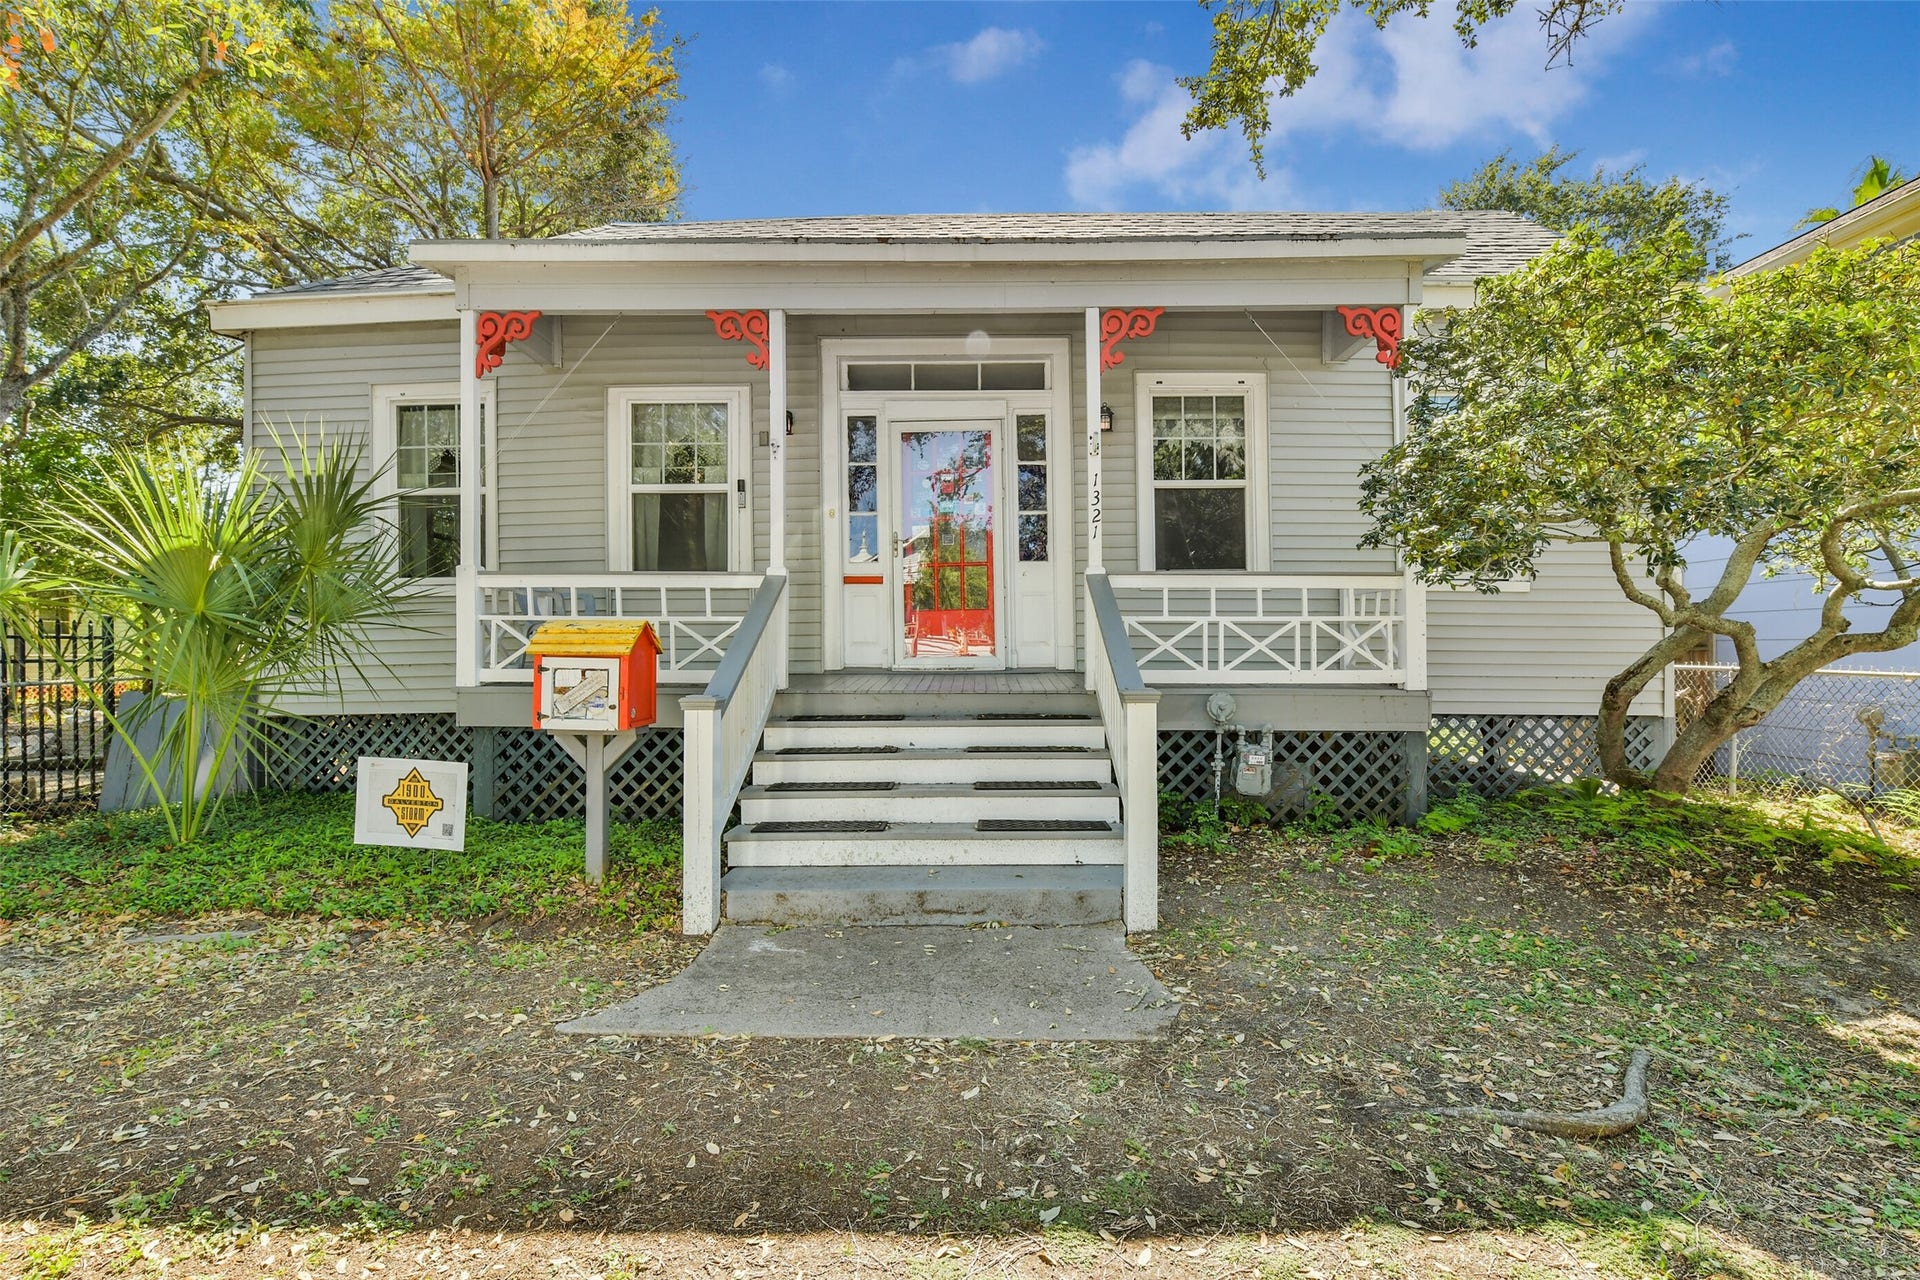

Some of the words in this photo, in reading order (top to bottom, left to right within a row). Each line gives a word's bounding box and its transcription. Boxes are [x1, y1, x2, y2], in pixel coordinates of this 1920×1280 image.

[1091, 473, 1101, 539] 1321
[402, 784, 425, 798] 1900
[401, 807, 424, 820] STORM
